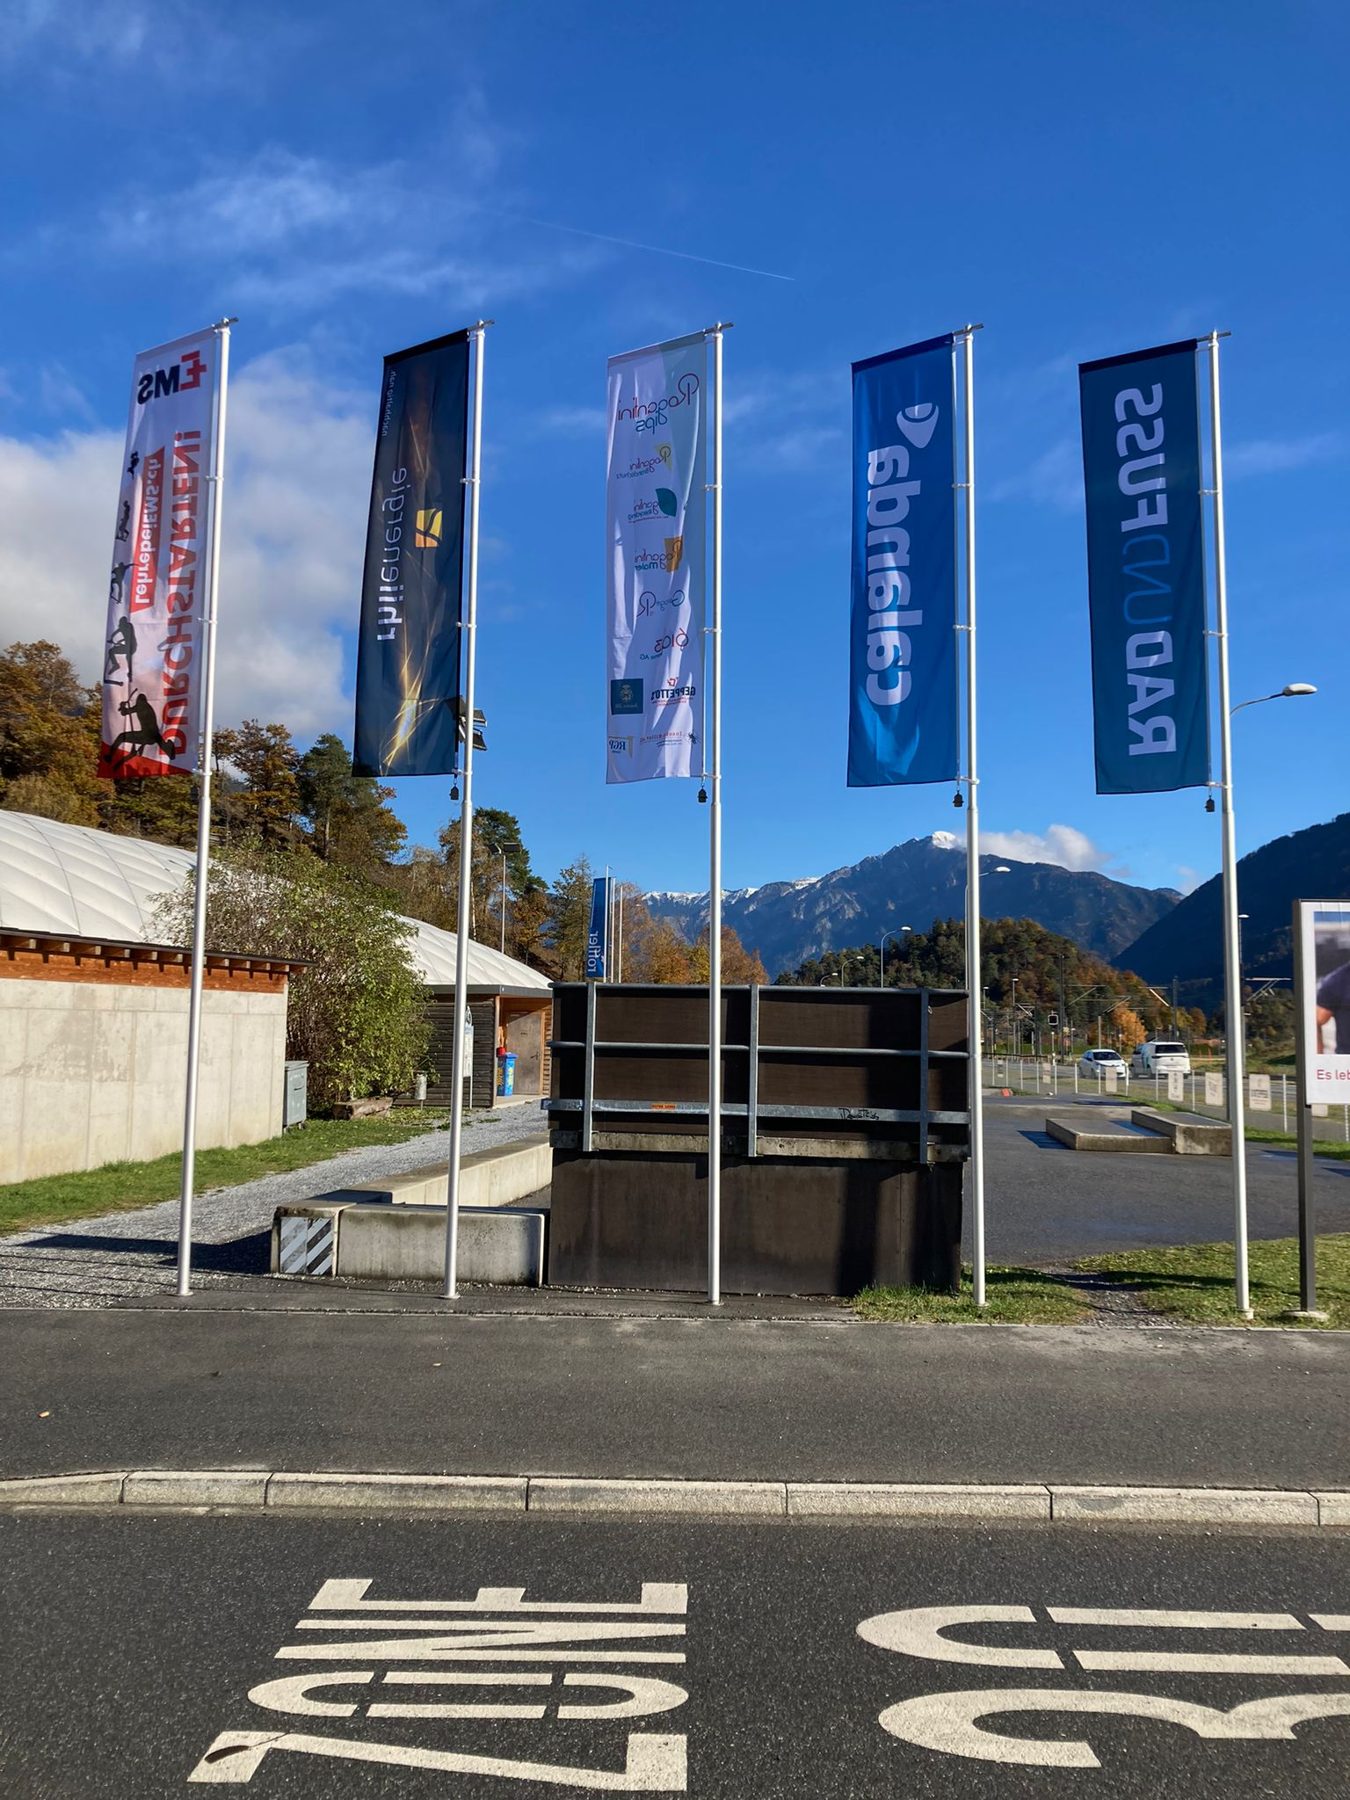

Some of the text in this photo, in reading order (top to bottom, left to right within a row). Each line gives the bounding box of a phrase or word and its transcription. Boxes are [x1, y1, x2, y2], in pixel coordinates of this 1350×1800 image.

[1316, 1069, 1332, 1081] Es
[187, 1578, 690, 1791] ZONE
[856, 1605, 1350, 1767] 30
